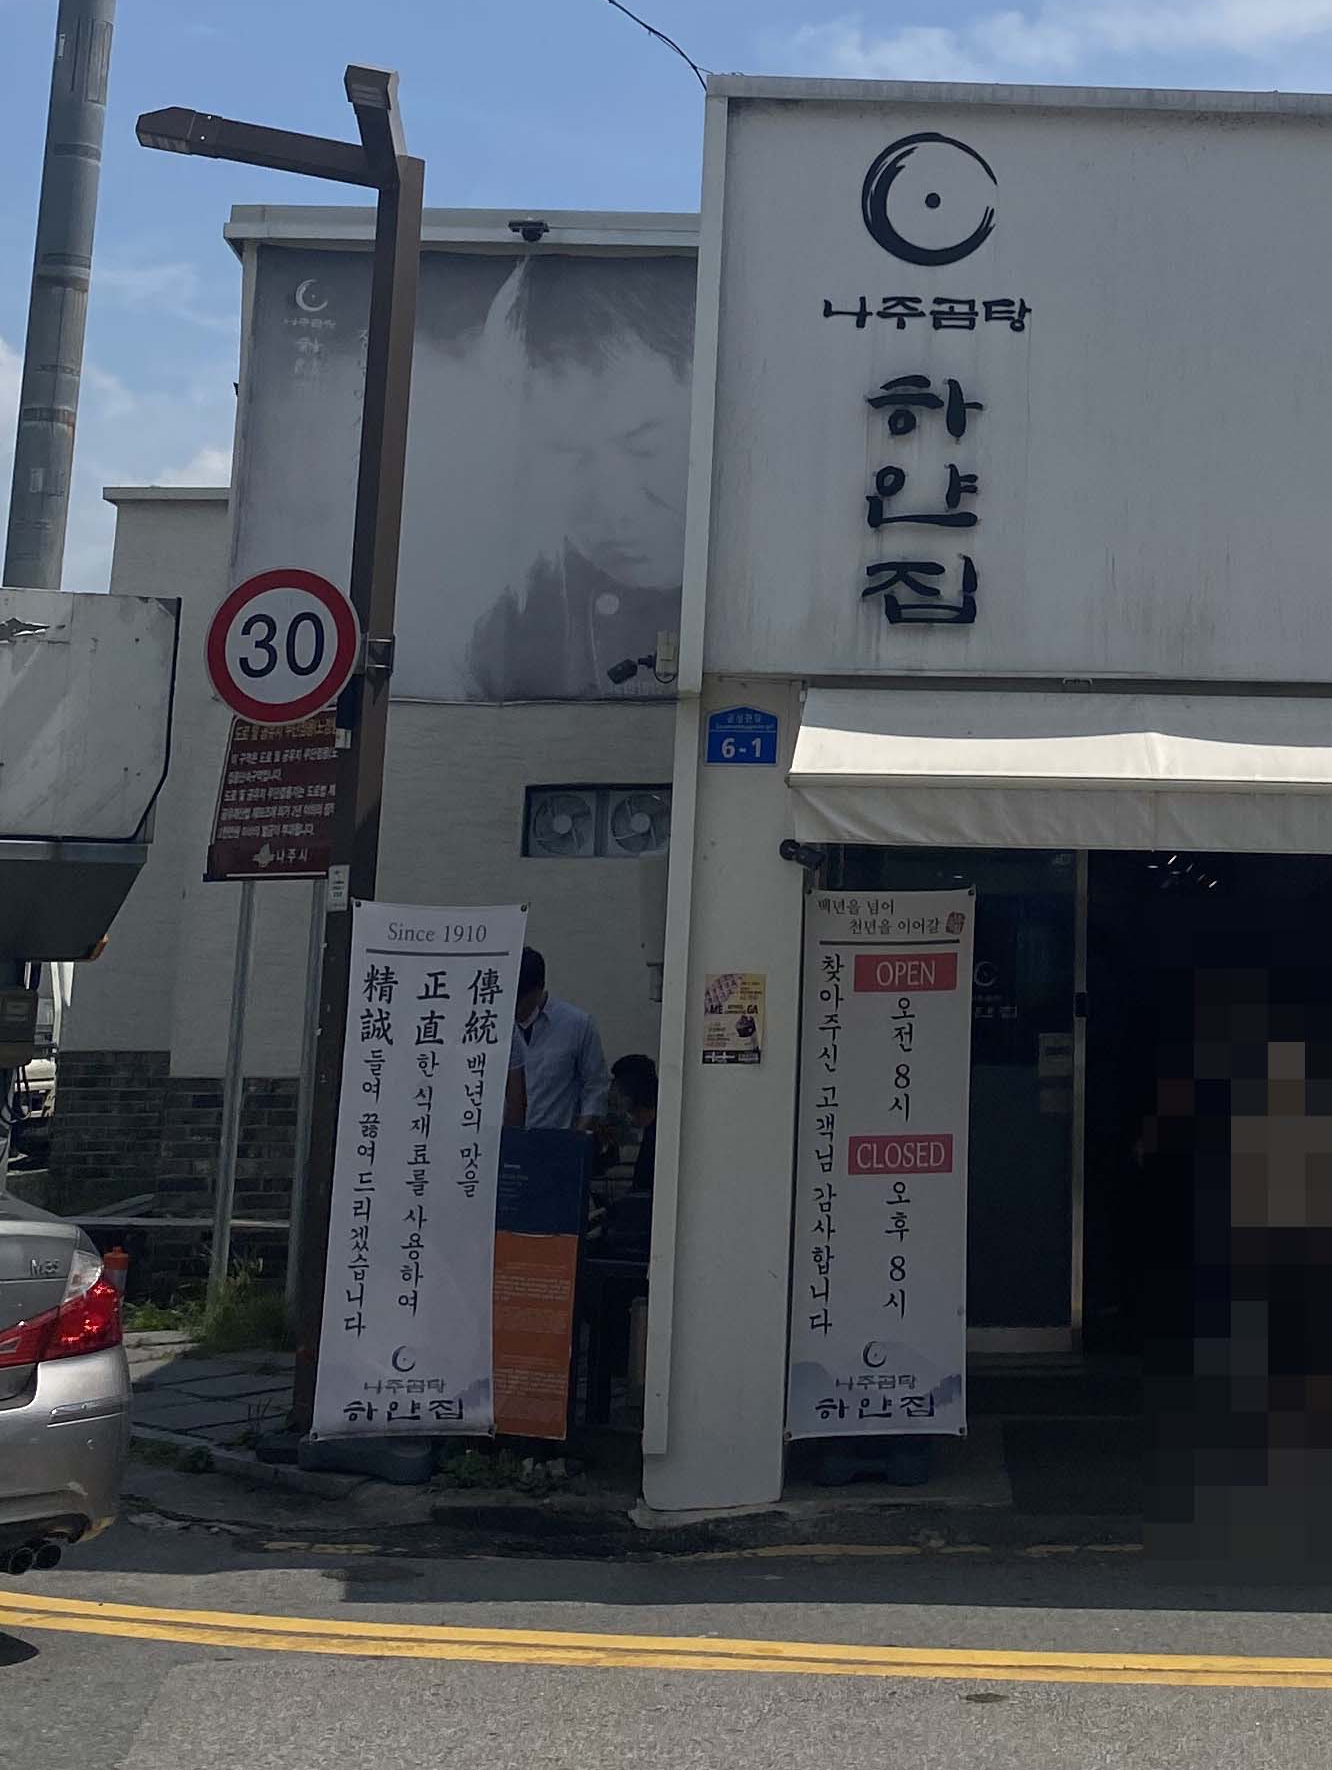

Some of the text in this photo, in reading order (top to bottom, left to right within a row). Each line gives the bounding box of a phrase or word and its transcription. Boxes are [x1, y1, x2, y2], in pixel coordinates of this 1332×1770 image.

[822, 295, 1032, 332] 나주곰탕
[861, 374, 984, 625] 하얀집
[239, 611, 325, 678] 30
[721, 737, 762, 759] 6-1
[276, 847, 309, 863] 나주시
[387, 922, 487, 943] Since 1910
[897, 917, 941, 935] 이어갈
[876, 961, 936, 986] OPEN
[889, 997, 916, 1123] 오전 8시
[461, 1052, 487, 1134] 백년의
[406, 1084, 434, 1197] 식재료를
[809, 955, 845, 1336] 찾아주신 고객님 감사합니다
[856, 1142, 945, 1170] CLOSED
[457, 1143, 483, 1198] 맛을
[398, 1205, 428, 1317] 사용하여
[883, 1181, 912, 1319] 오후 8시
[343, 1397, 464, 1422] 하얀집
[815, 1390, 935, 1420] 하얀집
